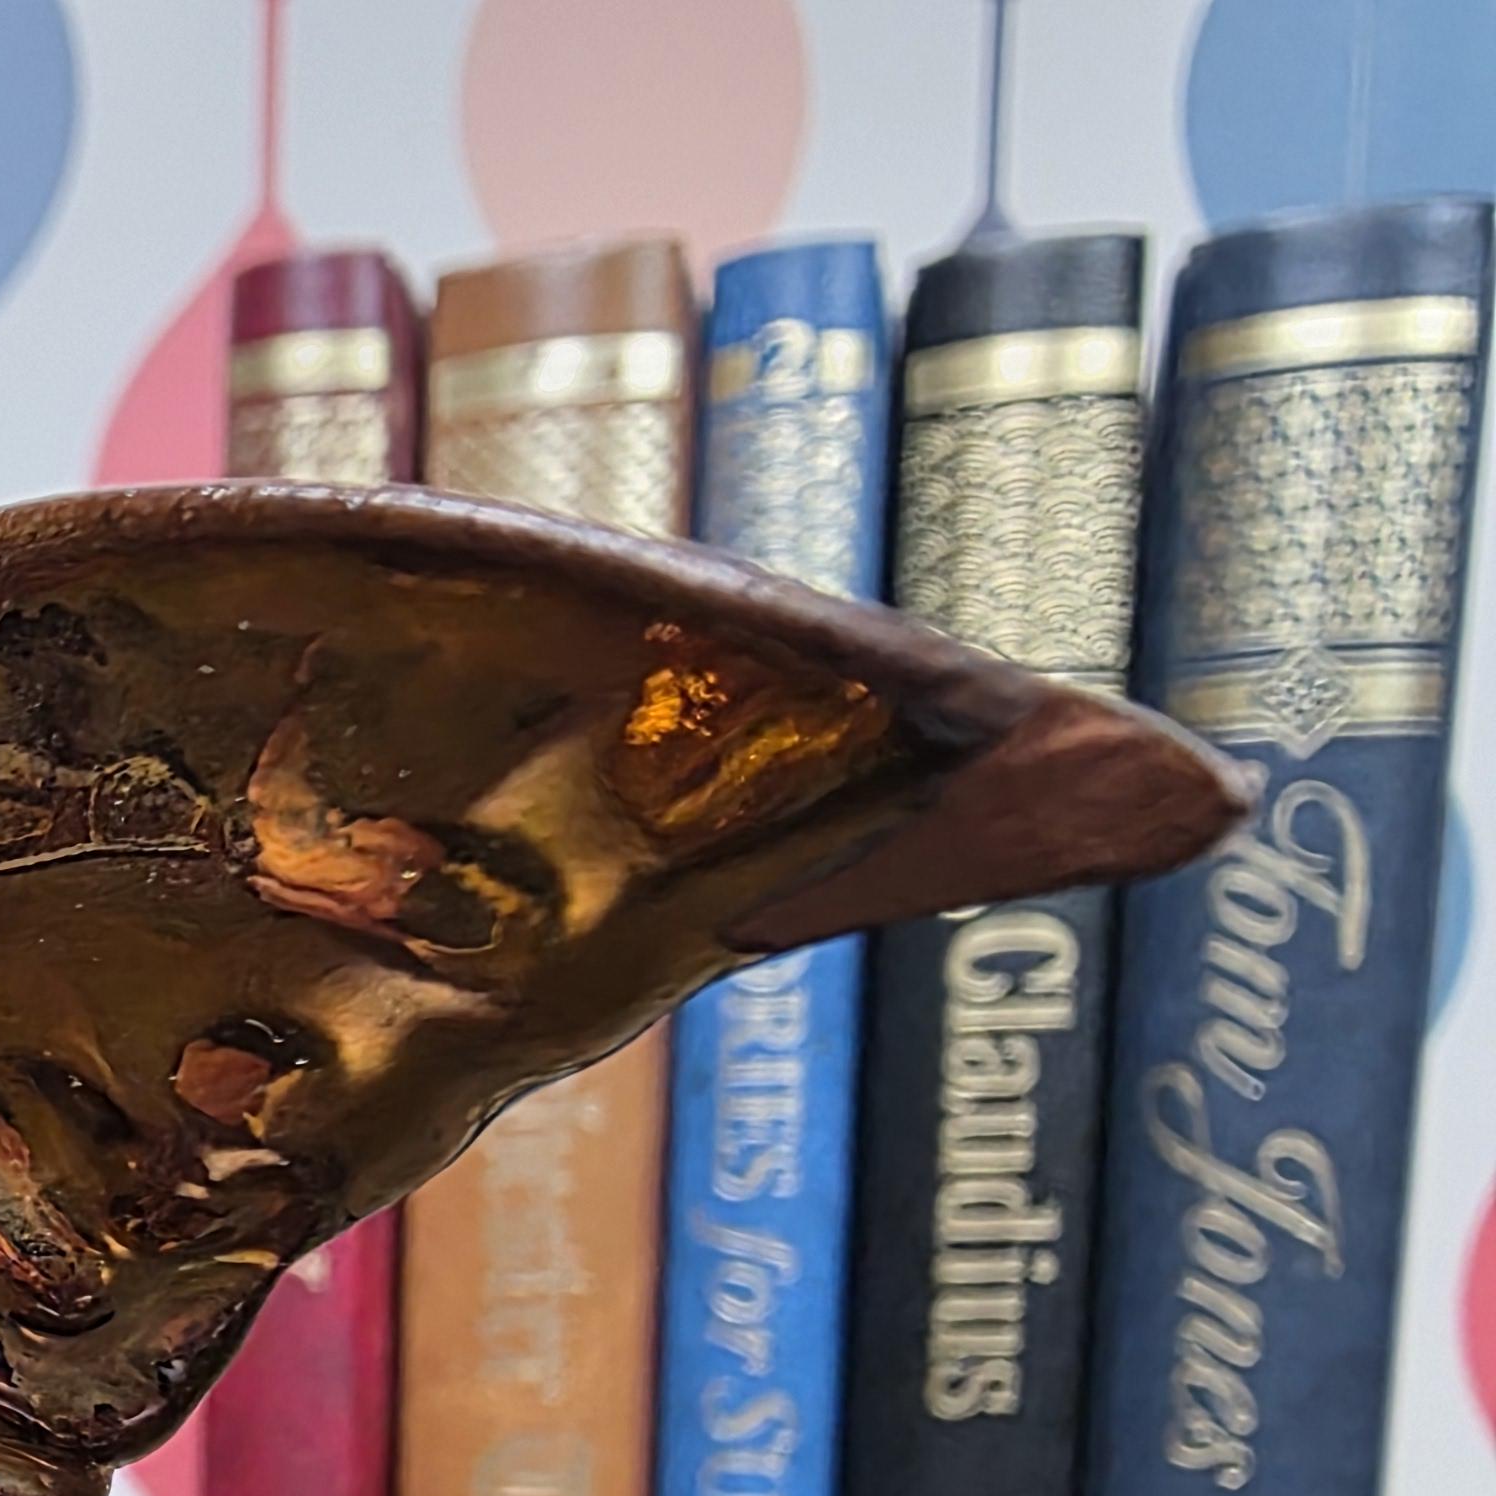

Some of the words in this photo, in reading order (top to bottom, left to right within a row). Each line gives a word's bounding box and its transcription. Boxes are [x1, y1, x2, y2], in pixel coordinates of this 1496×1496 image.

[1196, 779, 1372, 1101] Tom
[688, 1208, 799, 1378] for
[924, 911, 1080, 1421] Claudius
[1141, 1062, 1346, 1492] Jones
